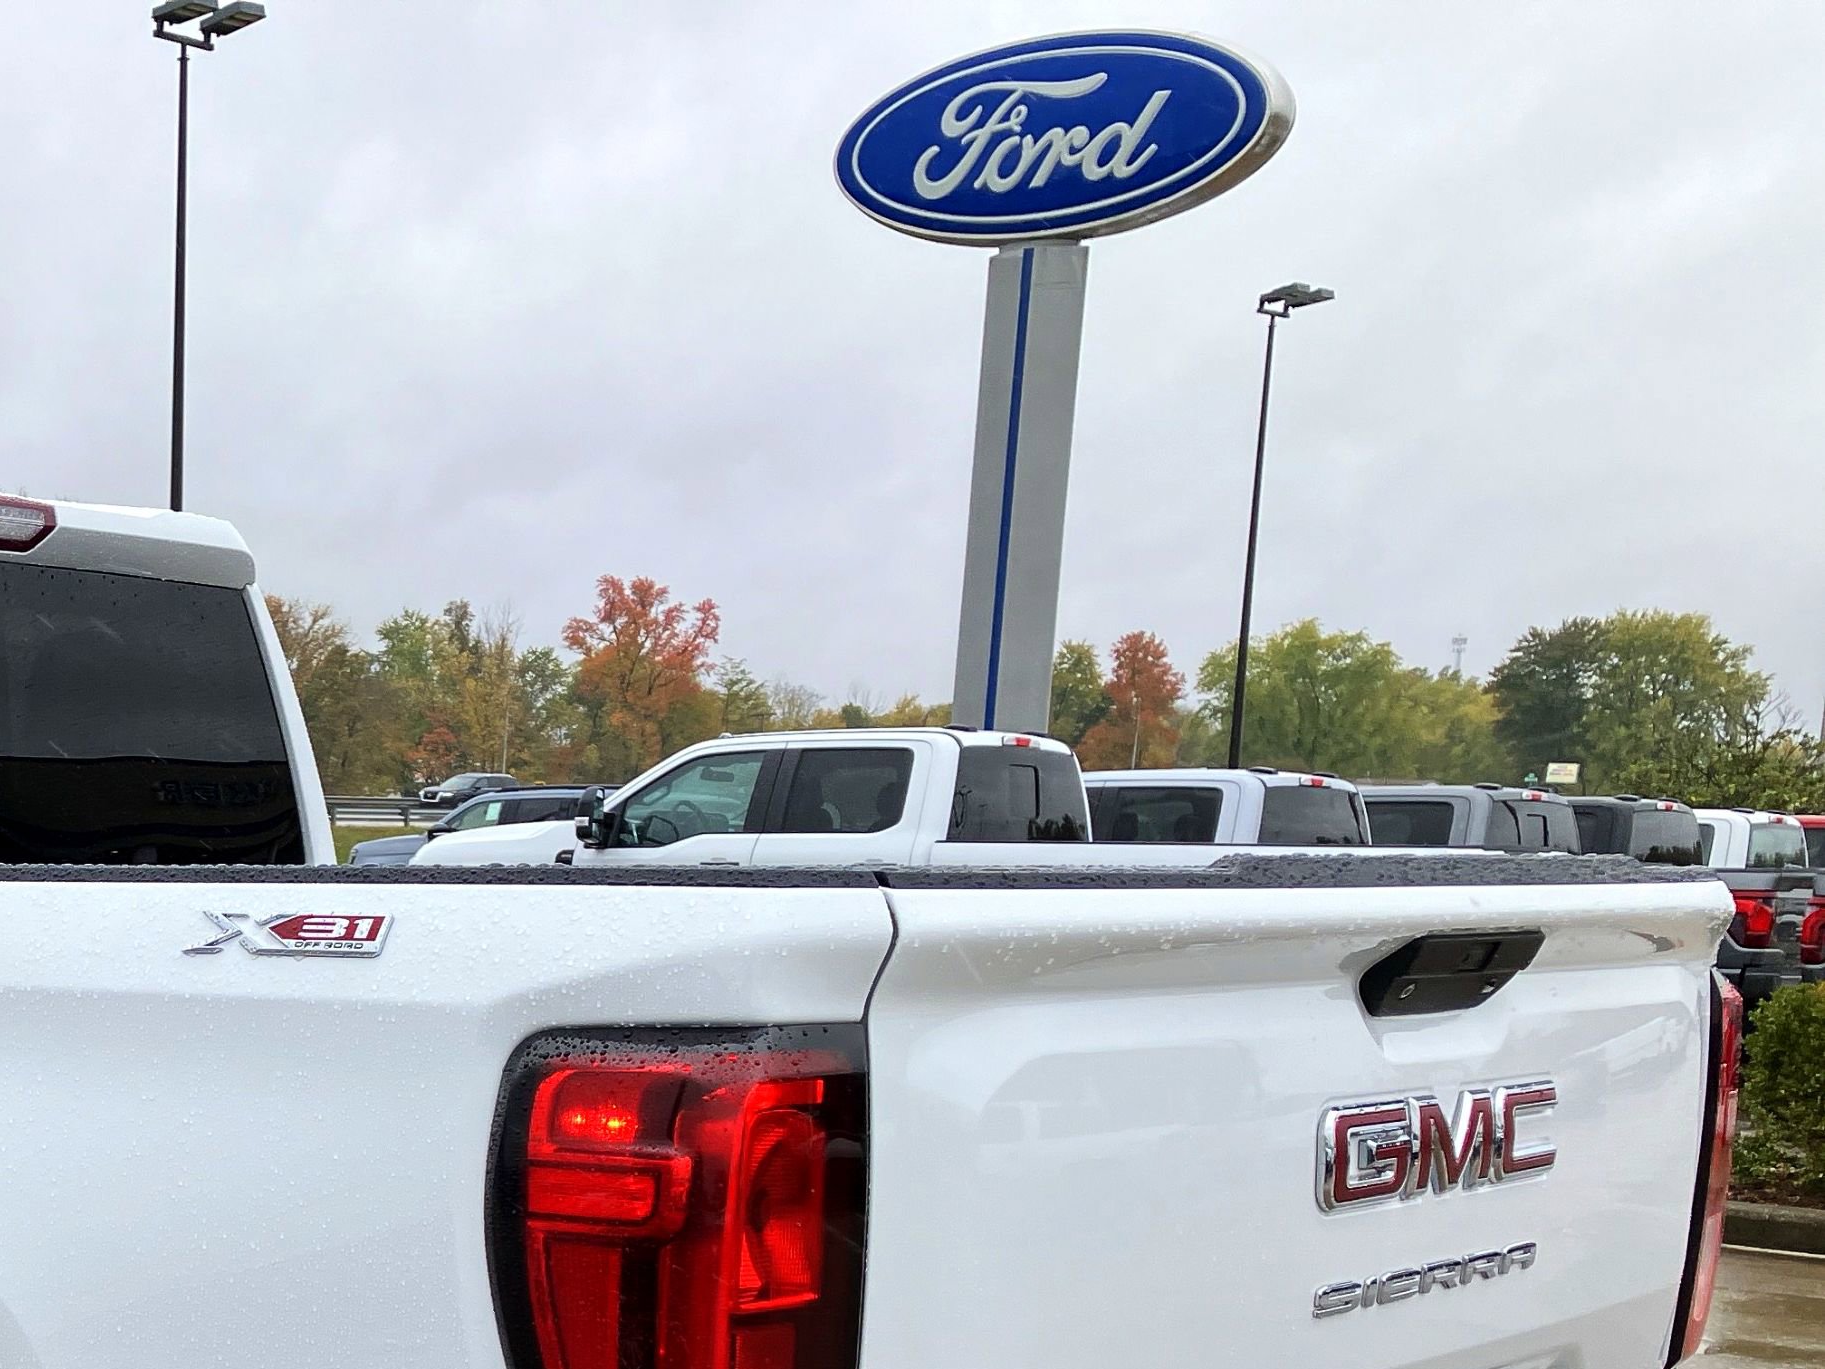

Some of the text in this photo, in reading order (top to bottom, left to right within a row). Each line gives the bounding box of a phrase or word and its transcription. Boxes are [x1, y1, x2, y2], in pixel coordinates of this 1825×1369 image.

[913, 72, 1172, 200] Ford
[294, 941, 364, 950] OFF ROAD
[1317, 1077, 1558, 1215] GMC
[1312, 1240, 1537, 1319] SIERRA
